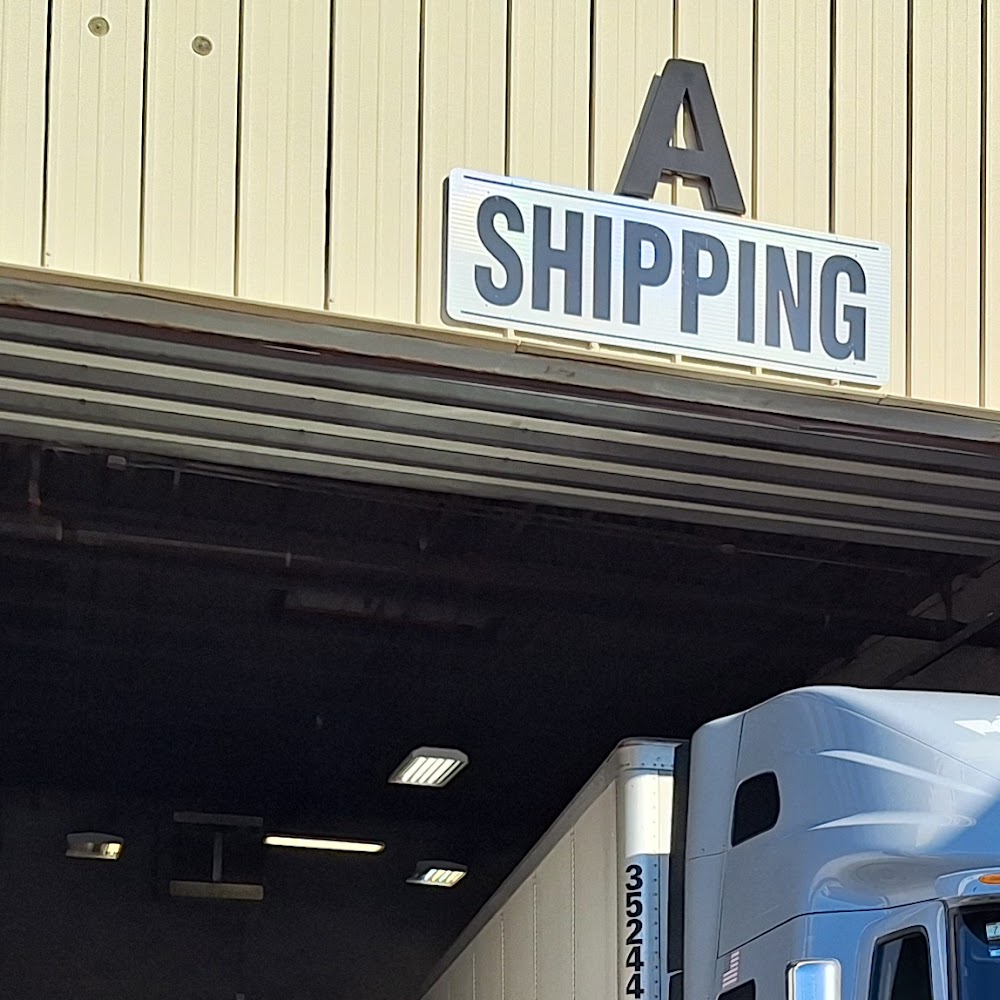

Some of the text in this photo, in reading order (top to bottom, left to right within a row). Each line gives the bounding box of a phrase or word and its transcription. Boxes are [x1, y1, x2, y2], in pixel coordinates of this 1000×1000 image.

[614, 58, 746, 215] A
[474, 195, 867, 361] SHIPPING
[625, 864, 645, 999] 35244
